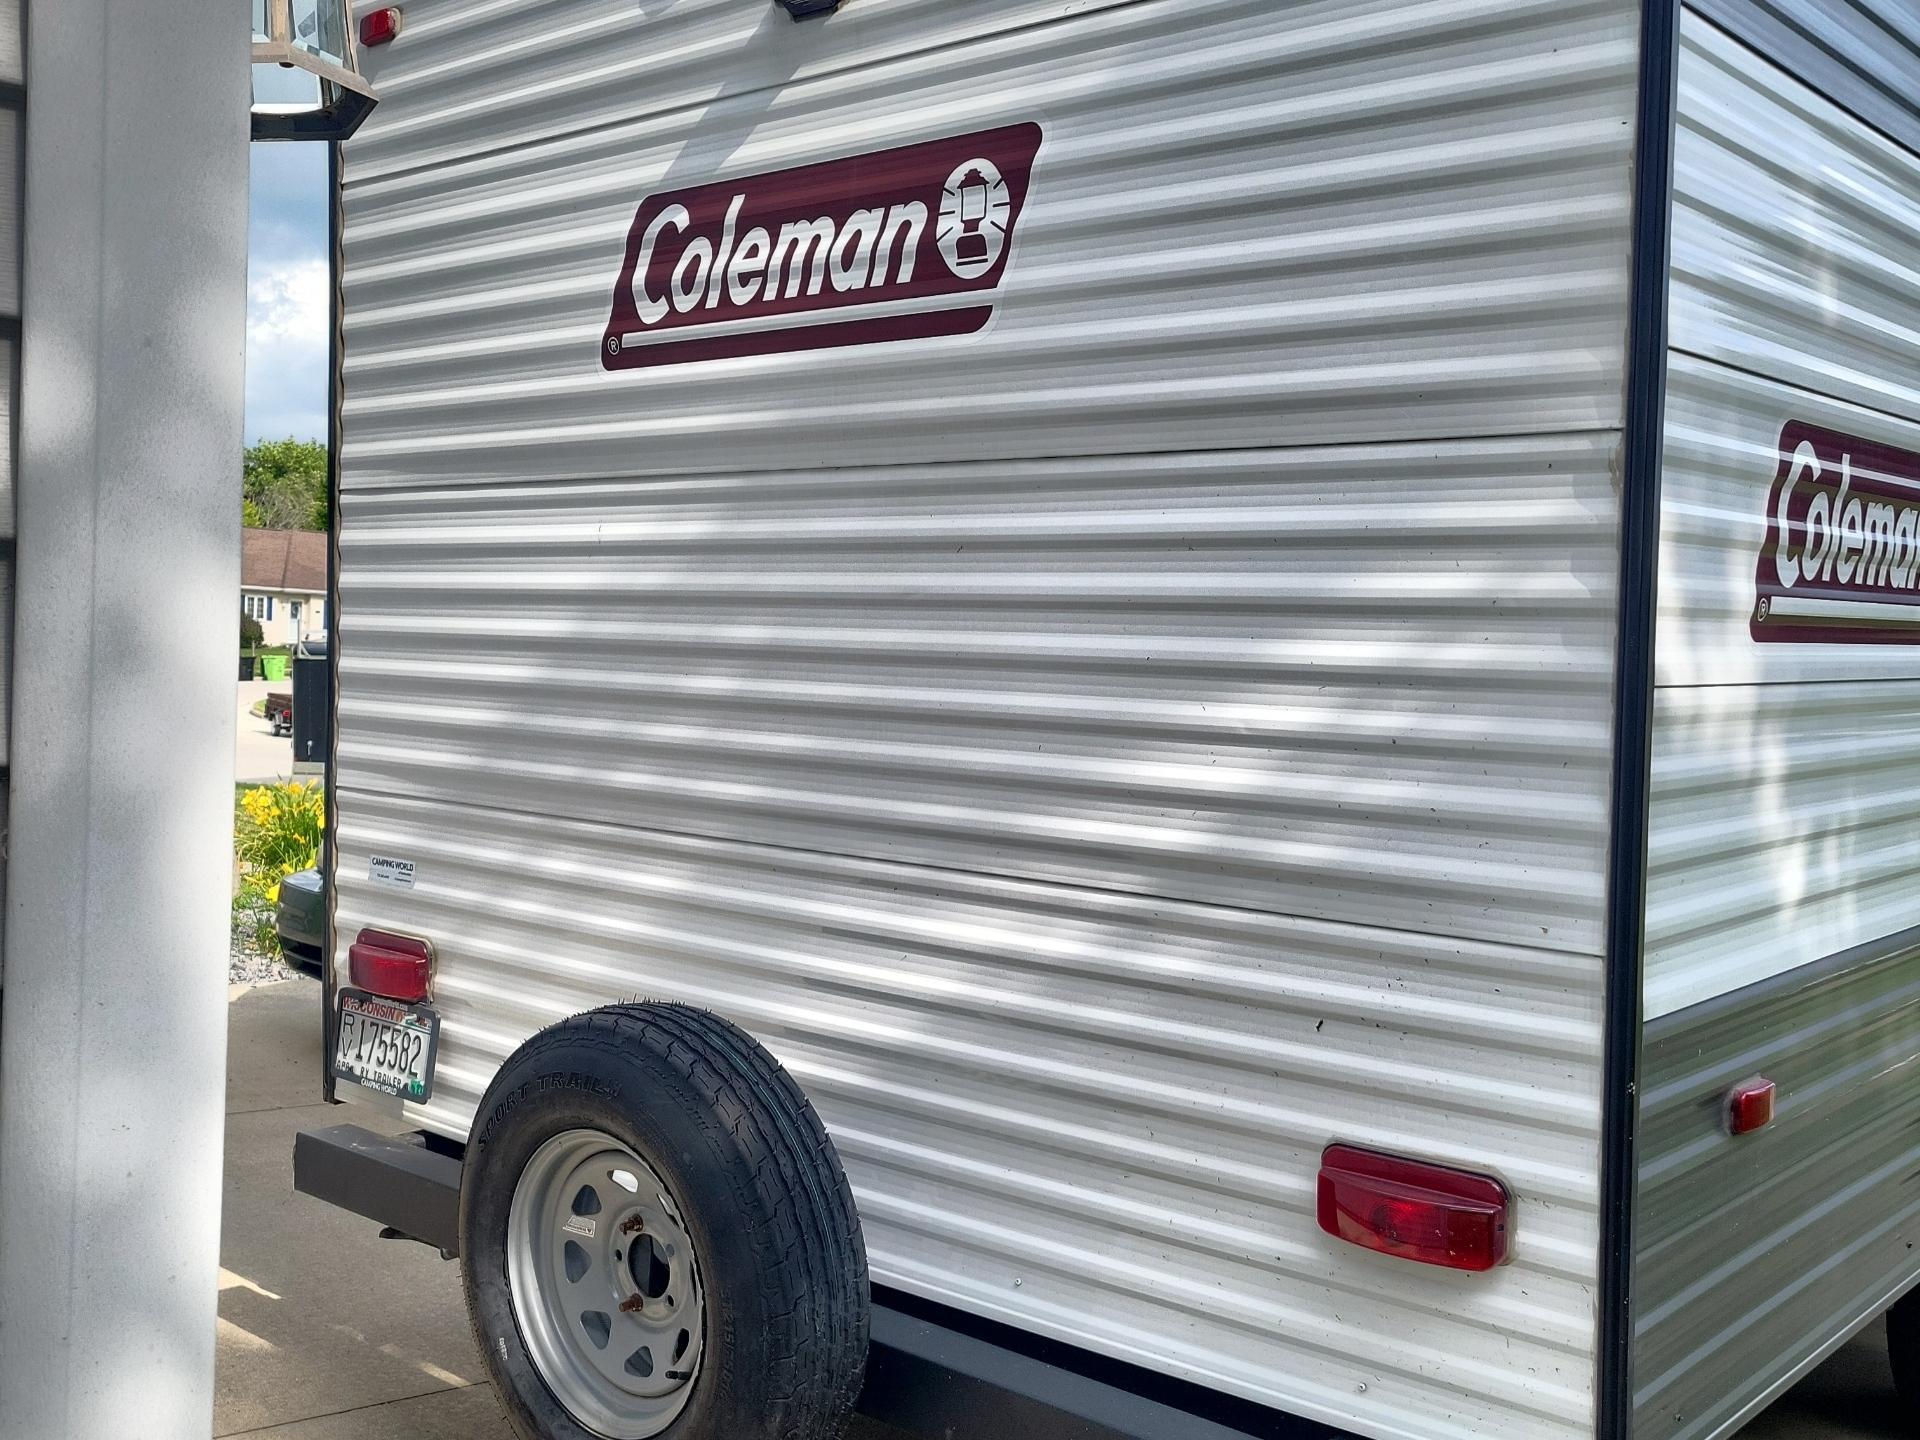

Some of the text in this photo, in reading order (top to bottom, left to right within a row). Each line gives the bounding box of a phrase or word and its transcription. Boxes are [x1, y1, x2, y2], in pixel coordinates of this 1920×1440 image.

[631, 194, 929, 325] Coleman
[371, 857, 414, 872] CAMPING WORLD
[355, 1019, 422, 1078] 175582
[361, 1078, 381, 1093] CAMPING
[380, 1083, 397, 1096] WORLD
[374, 1070, 402, 1090] TRAILER
[478, 1082, 530, 1153] SPORT
